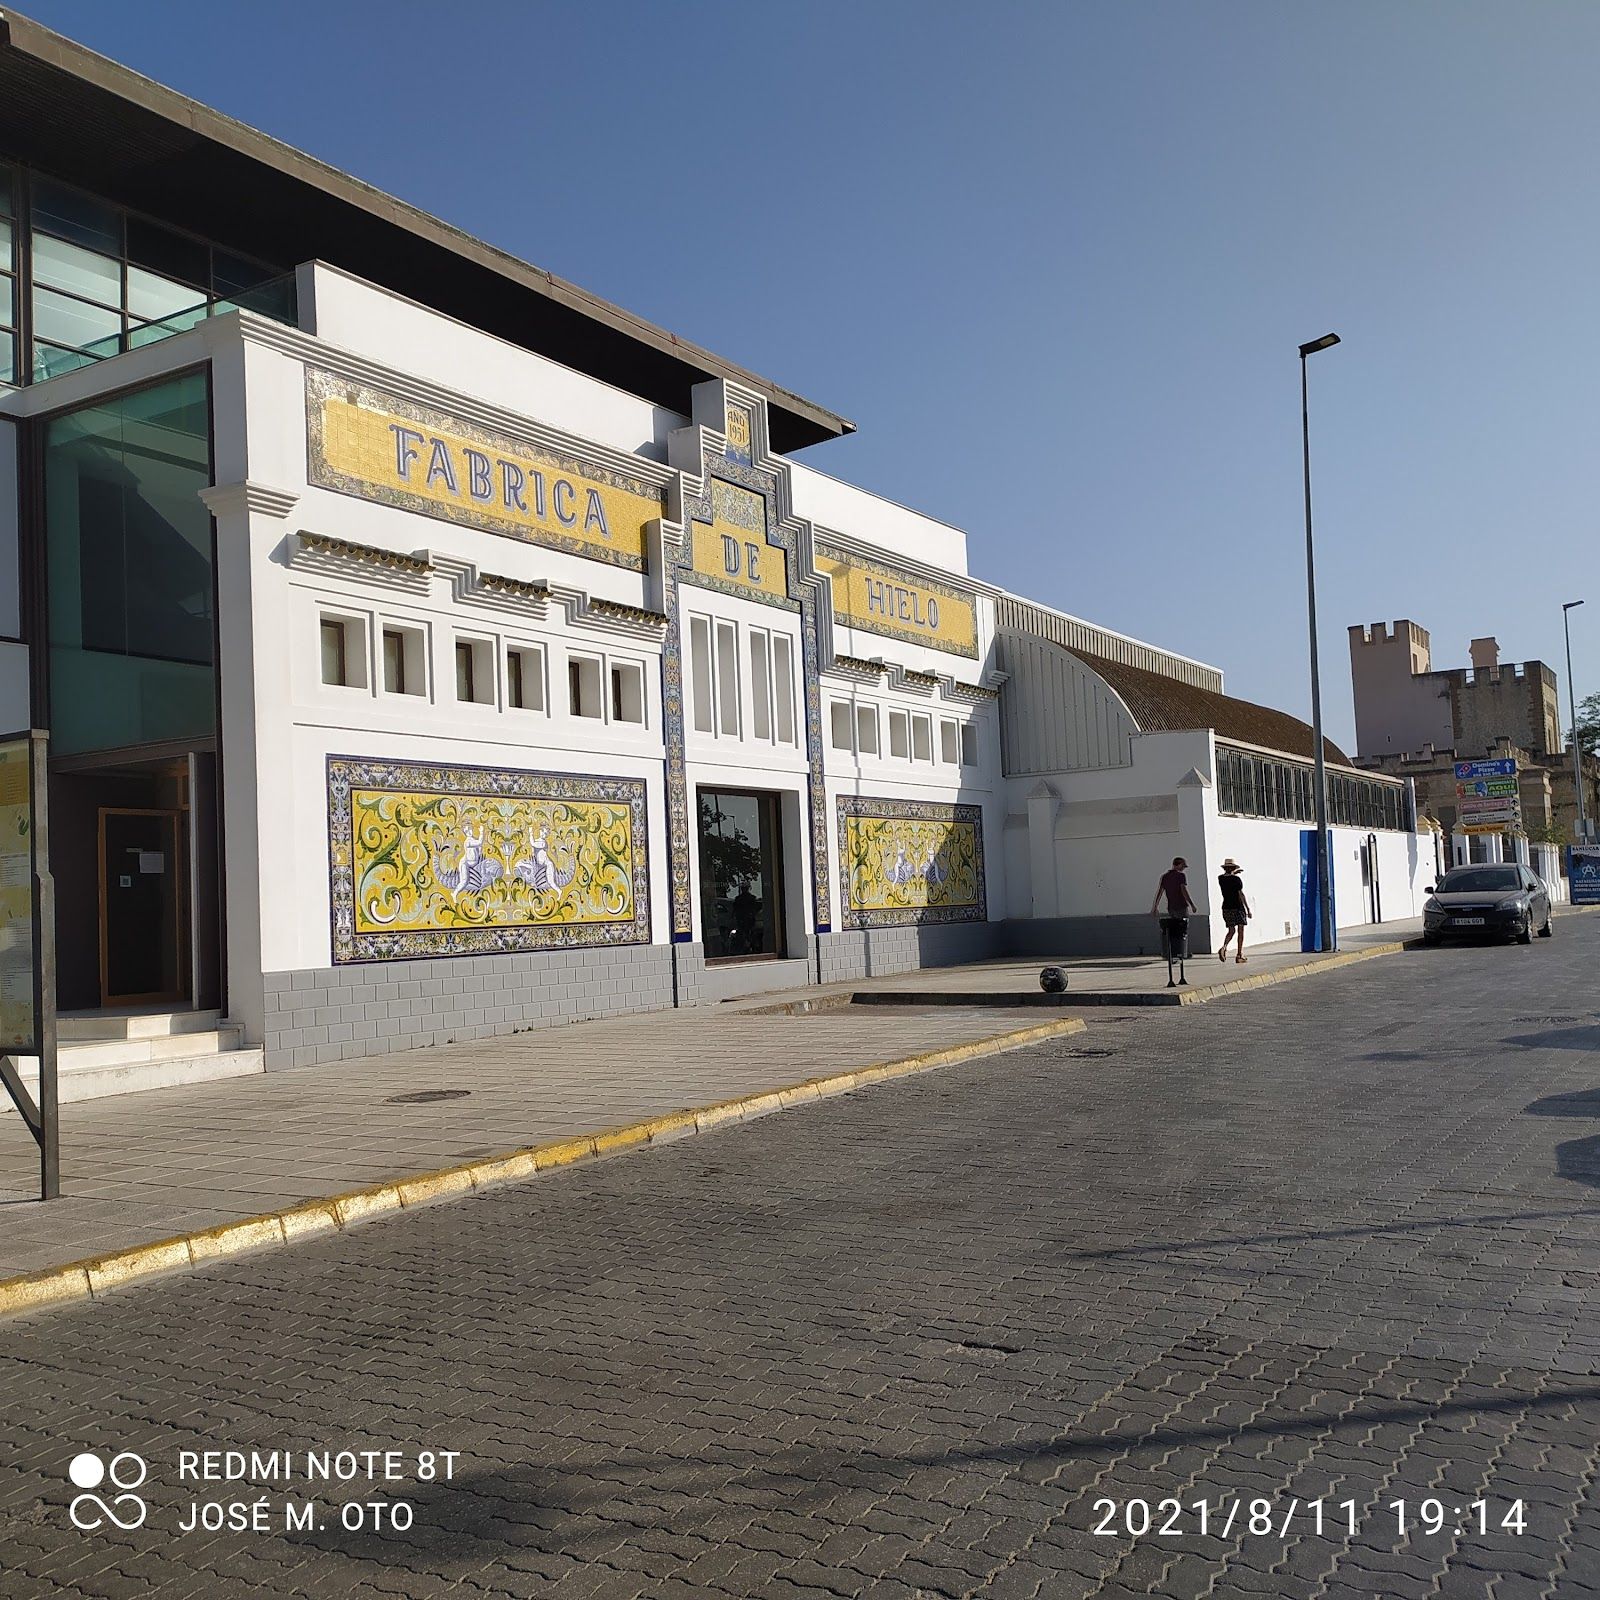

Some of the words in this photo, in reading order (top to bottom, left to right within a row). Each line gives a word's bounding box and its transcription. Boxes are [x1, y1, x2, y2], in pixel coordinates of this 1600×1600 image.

[729, 424, 745, 443] 1951
[388, 424, 611, 537] FABRICA
[720, 534, 762, 583] DE
[865, 577, 939, 630] HIELO
